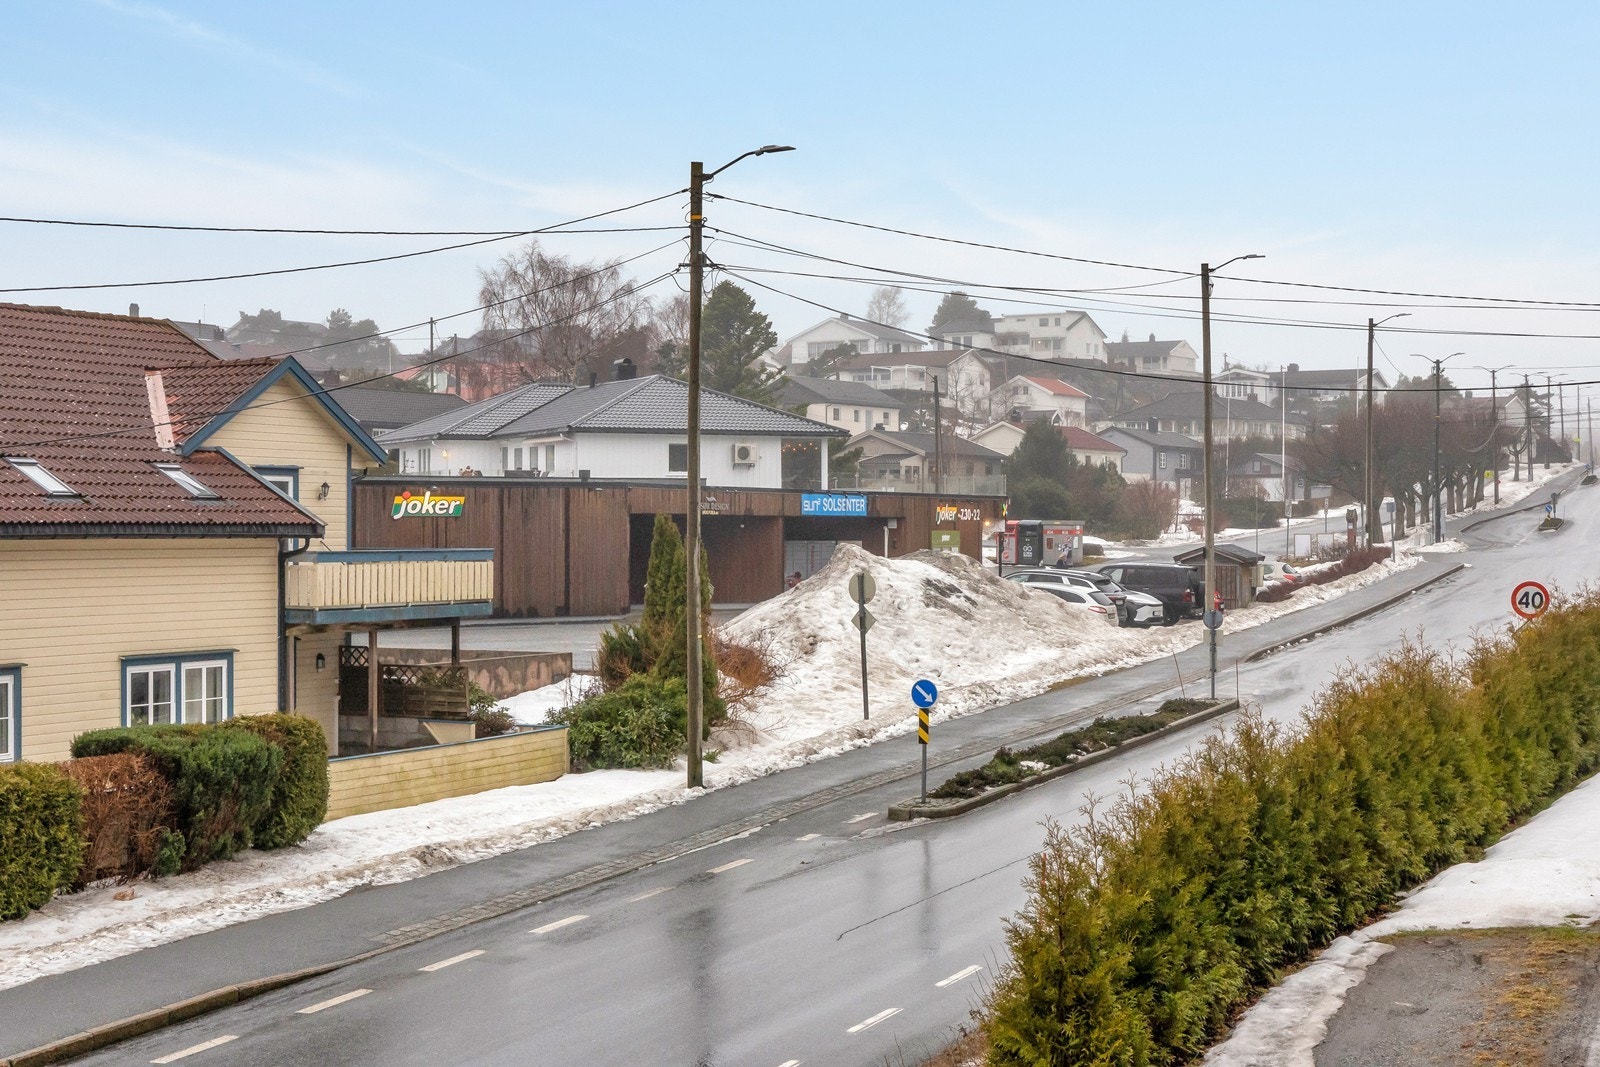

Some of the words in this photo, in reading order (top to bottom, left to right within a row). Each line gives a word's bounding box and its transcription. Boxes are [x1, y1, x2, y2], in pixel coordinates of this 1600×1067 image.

[393, 490, 461, 520] joker
[822, 497, 865, 512] SOLSENTER
[936, 503, 957, 525] joker
[1517, 591, 1544, 610] 40
